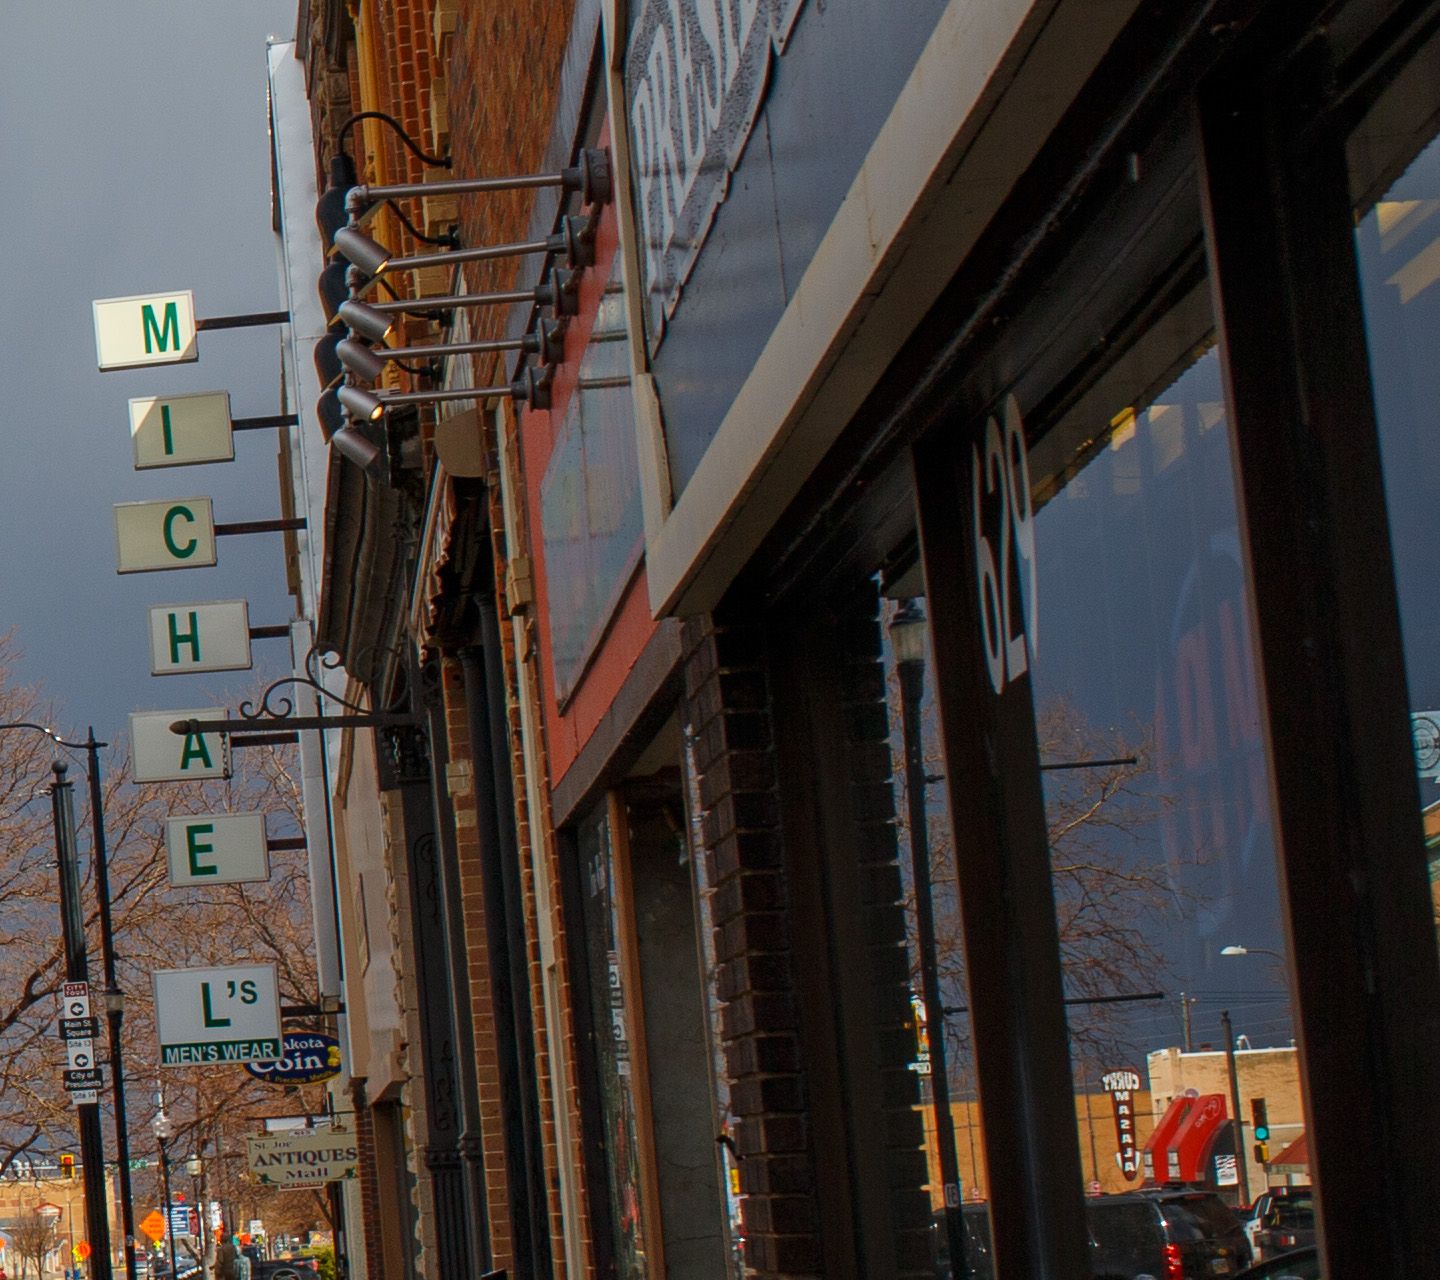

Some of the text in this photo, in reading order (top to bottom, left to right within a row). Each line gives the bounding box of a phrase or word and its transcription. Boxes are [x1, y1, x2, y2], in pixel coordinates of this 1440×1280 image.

[972, 394, 1037, 693] 629
[166, 1042, 274, 1064] MEN'S WEAR
[284, 1038, 325, 1049] akota
[254, 1147, 358, 1167] ANTIQUES
[286, 1167, 328, 1179] Mall
